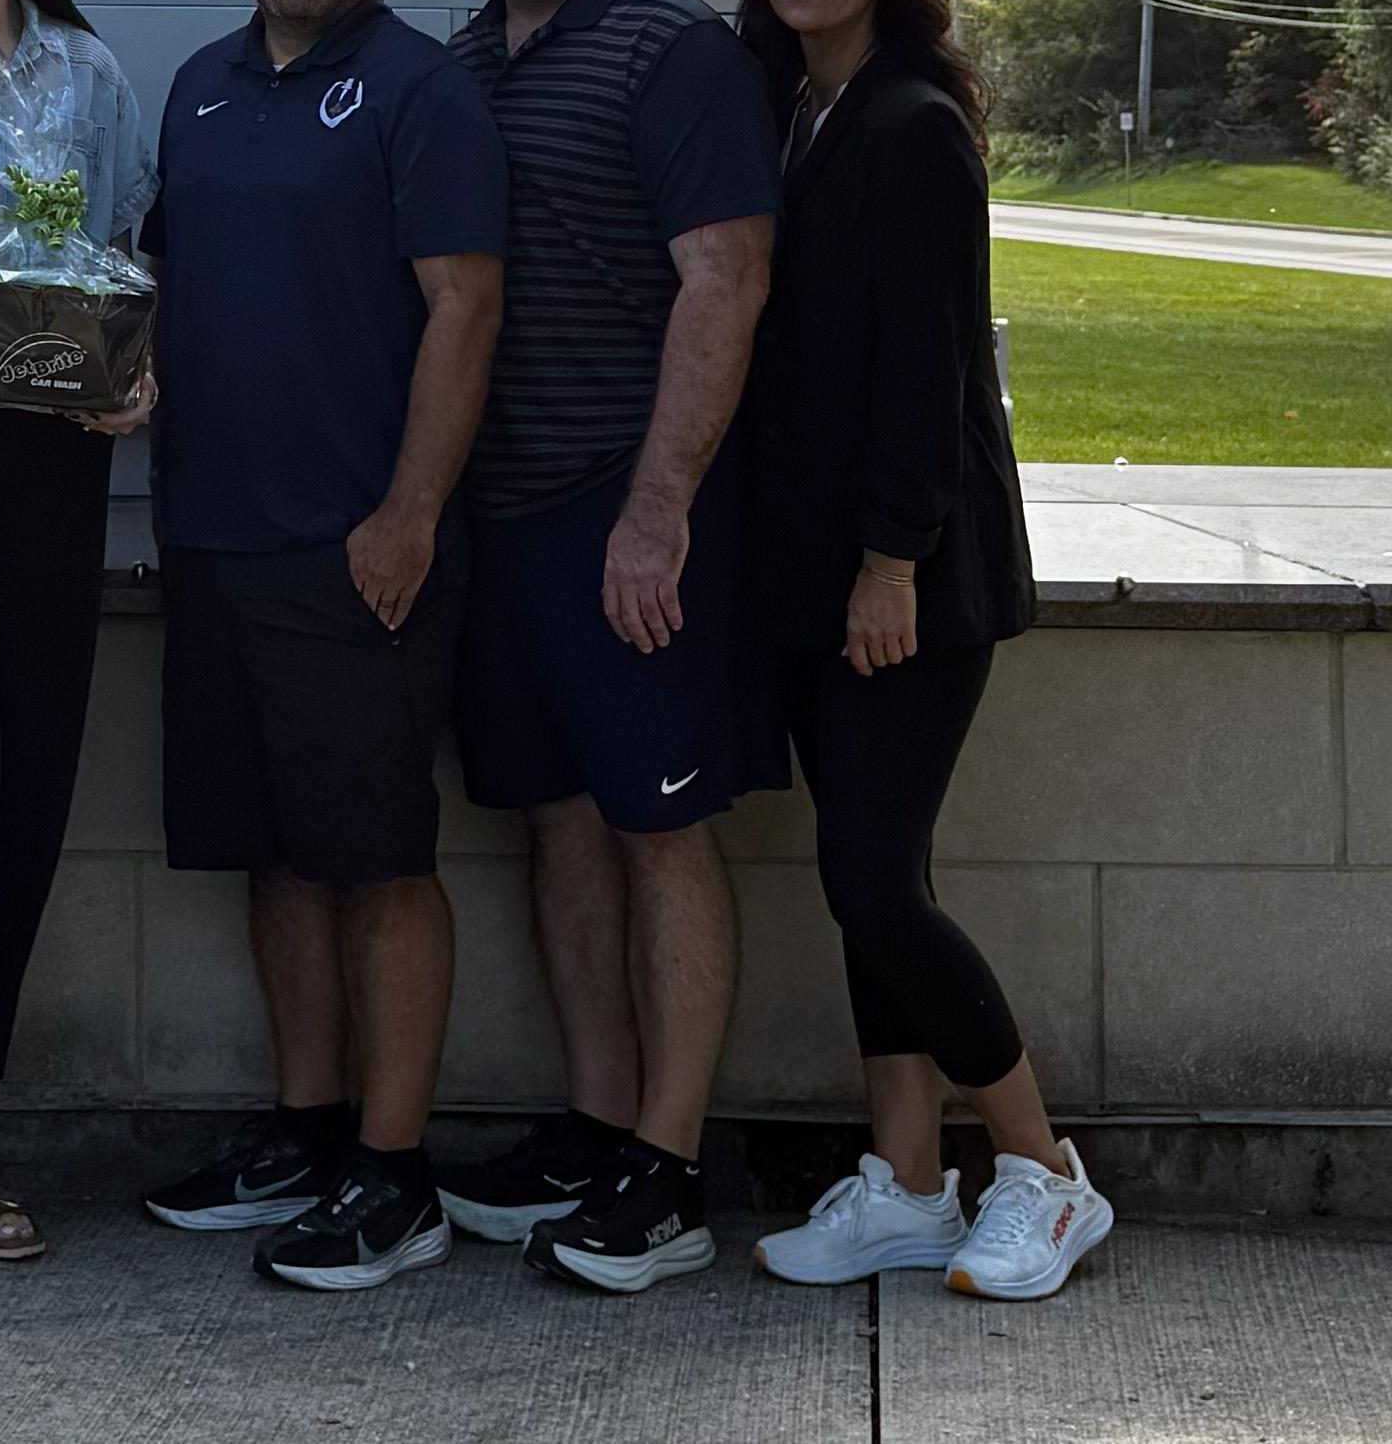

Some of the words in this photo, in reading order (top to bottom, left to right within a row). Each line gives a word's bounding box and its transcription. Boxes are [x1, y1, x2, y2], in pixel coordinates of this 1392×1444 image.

[1, 350, 83, 383] JetBrite
[30, 378, 51, 387] CAR
[54, 380, 81, 390] WASH
[644, 1212, 682, 1249] HOKA
